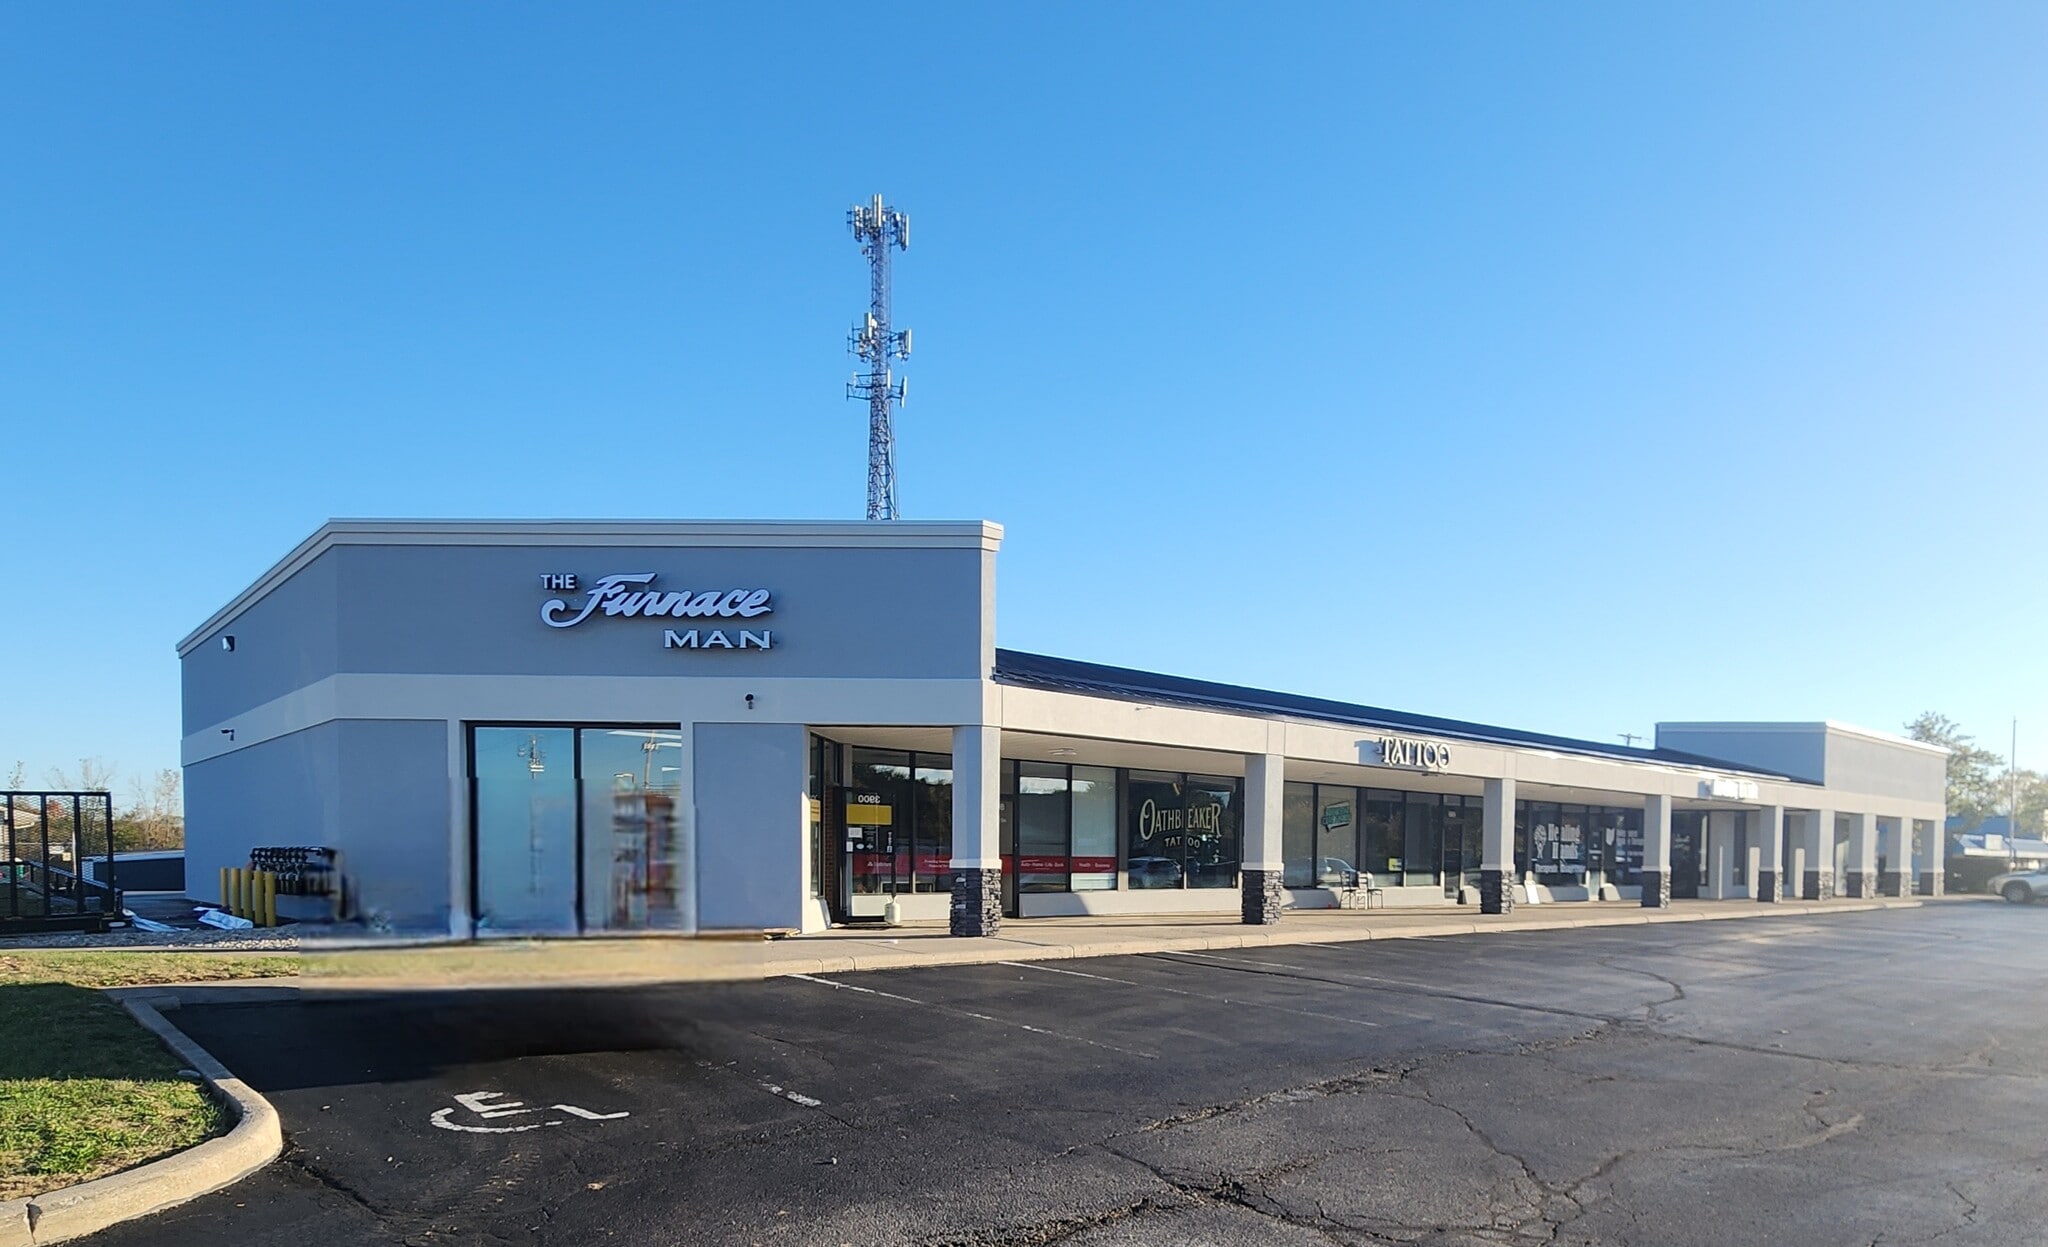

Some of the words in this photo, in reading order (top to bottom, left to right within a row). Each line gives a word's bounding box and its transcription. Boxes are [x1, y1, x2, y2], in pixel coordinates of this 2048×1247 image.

[540, 573, 576, 589] THE
[540, 572, 772, 628] Furnace
[663, 629, 772, 649] MAN
[1381, 736, 1451, 769] TATTOO
[1164, 836, 1200, 849] TATOO
